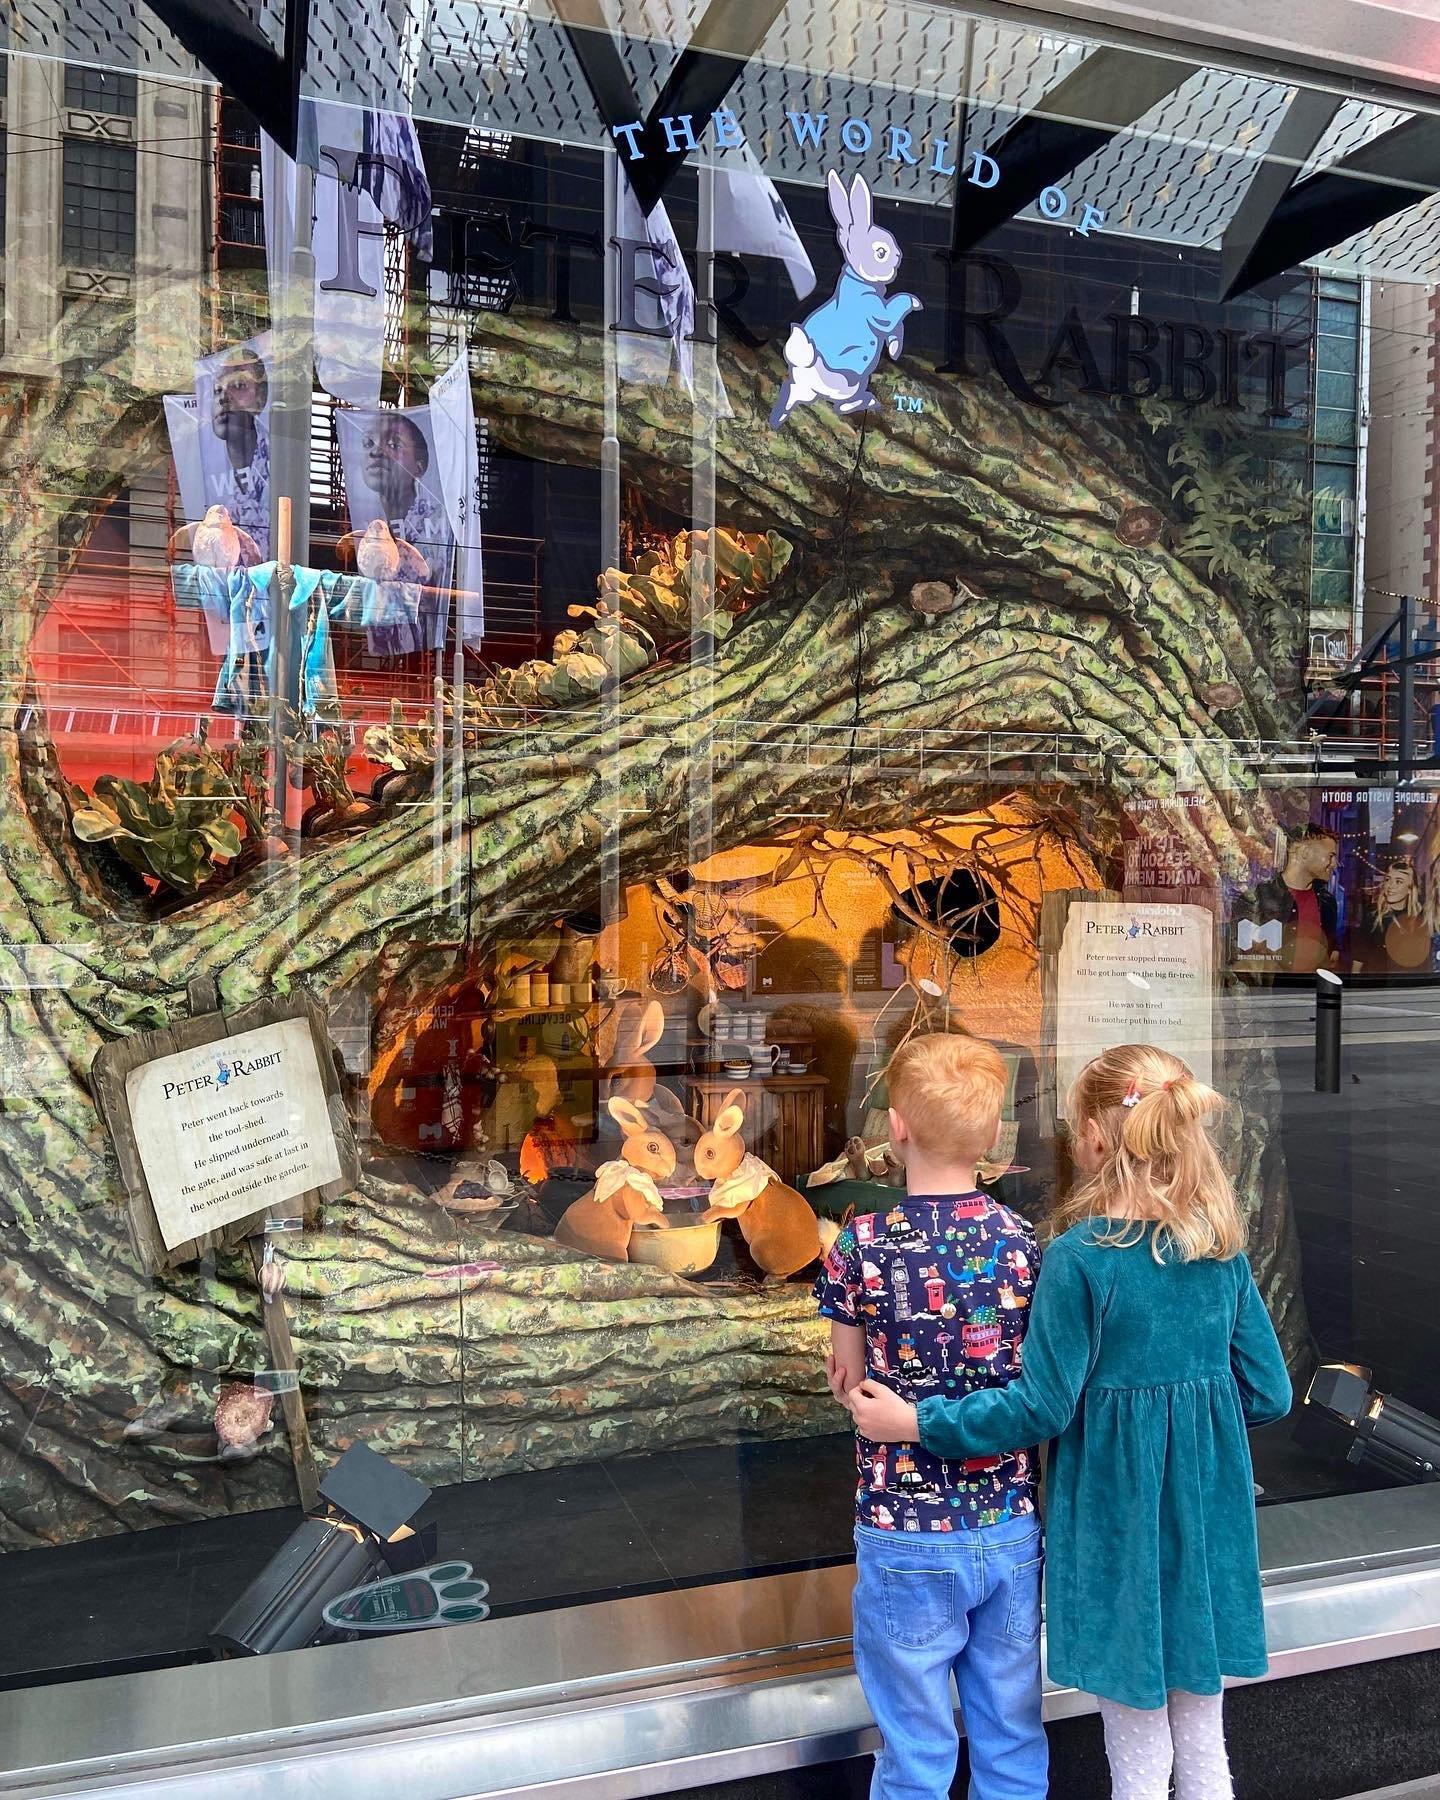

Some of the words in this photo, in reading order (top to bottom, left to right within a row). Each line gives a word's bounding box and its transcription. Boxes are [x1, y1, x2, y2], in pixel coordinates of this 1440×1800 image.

[612, 110, 742, 161] THE
[785, 111, 1001, 189] WORLD
[1038, 186, 1105, 237] OF
[320, 144, 768, 348] PETER
[933, 248, 1315, 418] RABBIT
[893, 394, 923, 414] TM
[1086, 921, 1125, 935] PETER
[1142, 922, 1185, 938] RABBIT
[1086, 953, 1105, 962] Peter
[1127, 955, 1156, 964] stopped
[1157, 957, 1187, 965] running
[1155, 971, 1167, 980] big
[1101, 1016, 1128, 1024] mother
[1129, 1018, 1142, 1026] put
[1143, 1017, 1158, 1025] him
[1108, 1001, 1119, 1009] He
[162, 1075, 214, 1100] PETER
[232, 1050, 282, 1077] RABBIT
[181, 1117, 205, 1132] Peter
[206, 1109, 228, 1123] went
[229, 1100, 250, 1116] back
[250, 1090, 284, 1107] towards
[208, 1131, 223, 1143] the
[224, 1116, 267, 1137] tool-shed.
[194, 1158, 207, 1170] He
[209, 1146, 241, 1167] slipped
[241, 1128, 289, 1153] underneath
[181, 1184, 196, 1196] the
[198, 1177, 219, 1193] gate,
[220, 1168, 237, 1181] and
[238, 1162, 255, 1174] was
[256, 1154, 273, 1168] safe
[274, 1150, 283, 1161] at
[284, 1145, 299, 1158] last
[300, 1142, 309, 1152] in
[190, 1202, 205, 1214] the
[206, 1190, 230, 1207] wood
[231, 1179, 263, 1197] outside
[263, 1173, 278, 1186] the
[279, 1162, 310, 1184] garden.
